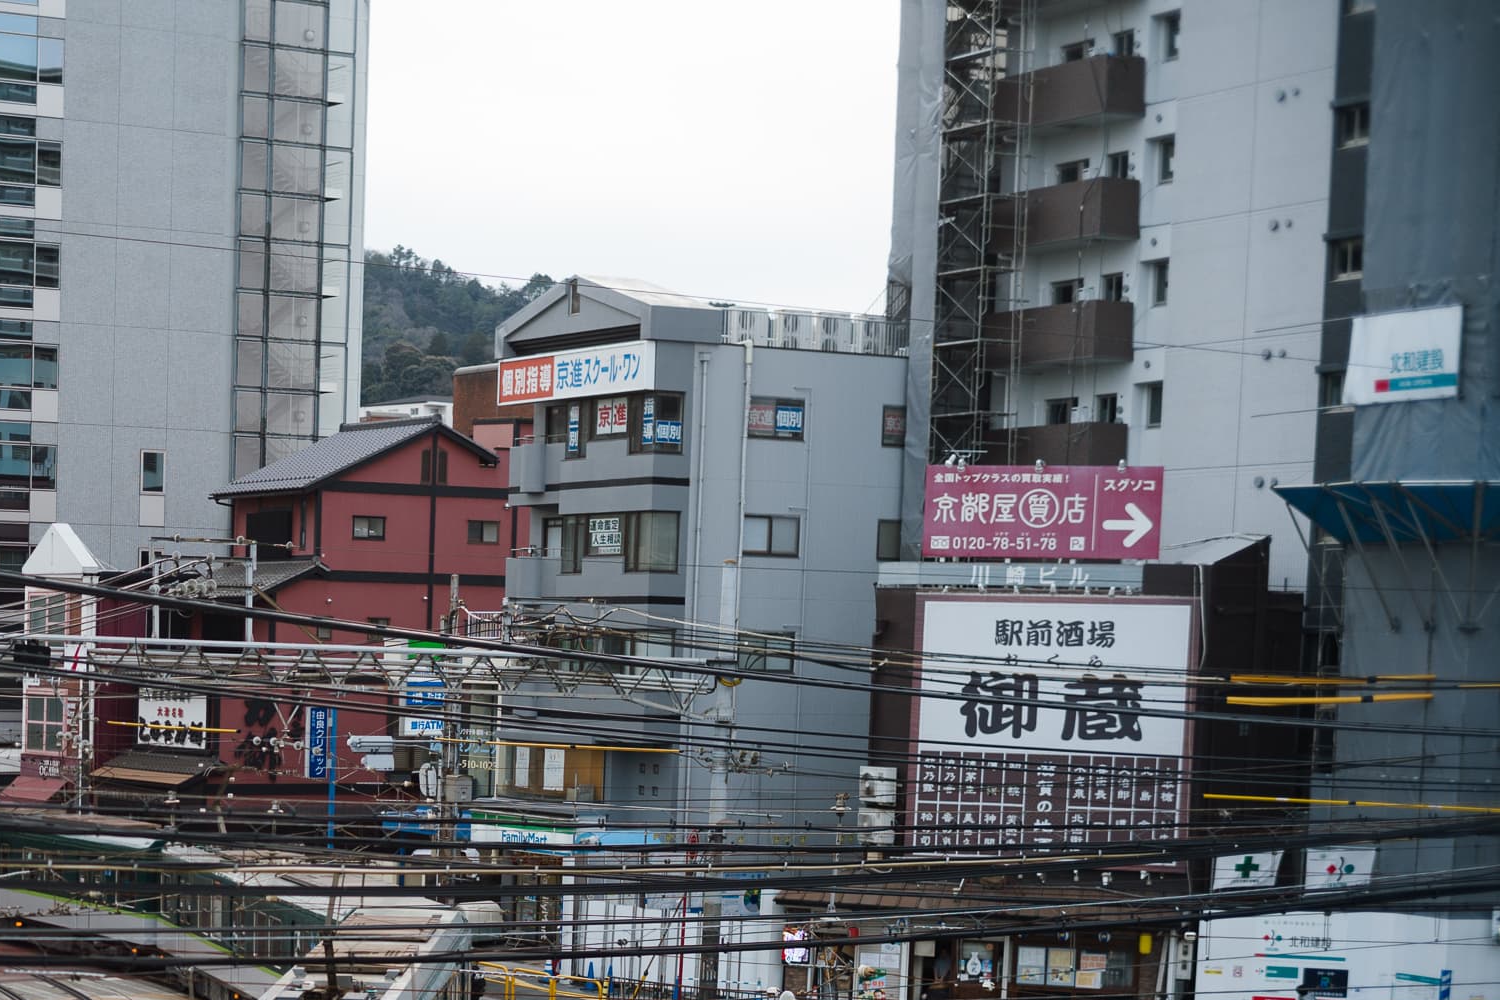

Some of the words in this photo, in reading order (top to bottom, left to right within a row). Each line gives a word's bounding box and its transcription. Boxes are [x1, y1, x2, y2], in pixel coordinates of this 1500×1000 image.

[502, 364, 552, 396] 個別指導
[556, 354, 641, 389] 京進スクール・ワン
[598, 403, 628, 428] 京進
[776, 410, 802, 428] 個別
[657, 423, 682, 441] 個別
[933, 472, 1070, 485] 全国トップクラスの買取実績！
[1103, 479, 1157, 492] スグソコ
[952, 536, 1057, 550] 0120-78-51-78
[994, 619, 1116, 648] 駅前酒場
[960, 671, 1144, 741] 御蔵
[411, 720, 445, 730] 銀行ATM
[501, 830, 548, 843] FamilyMart
